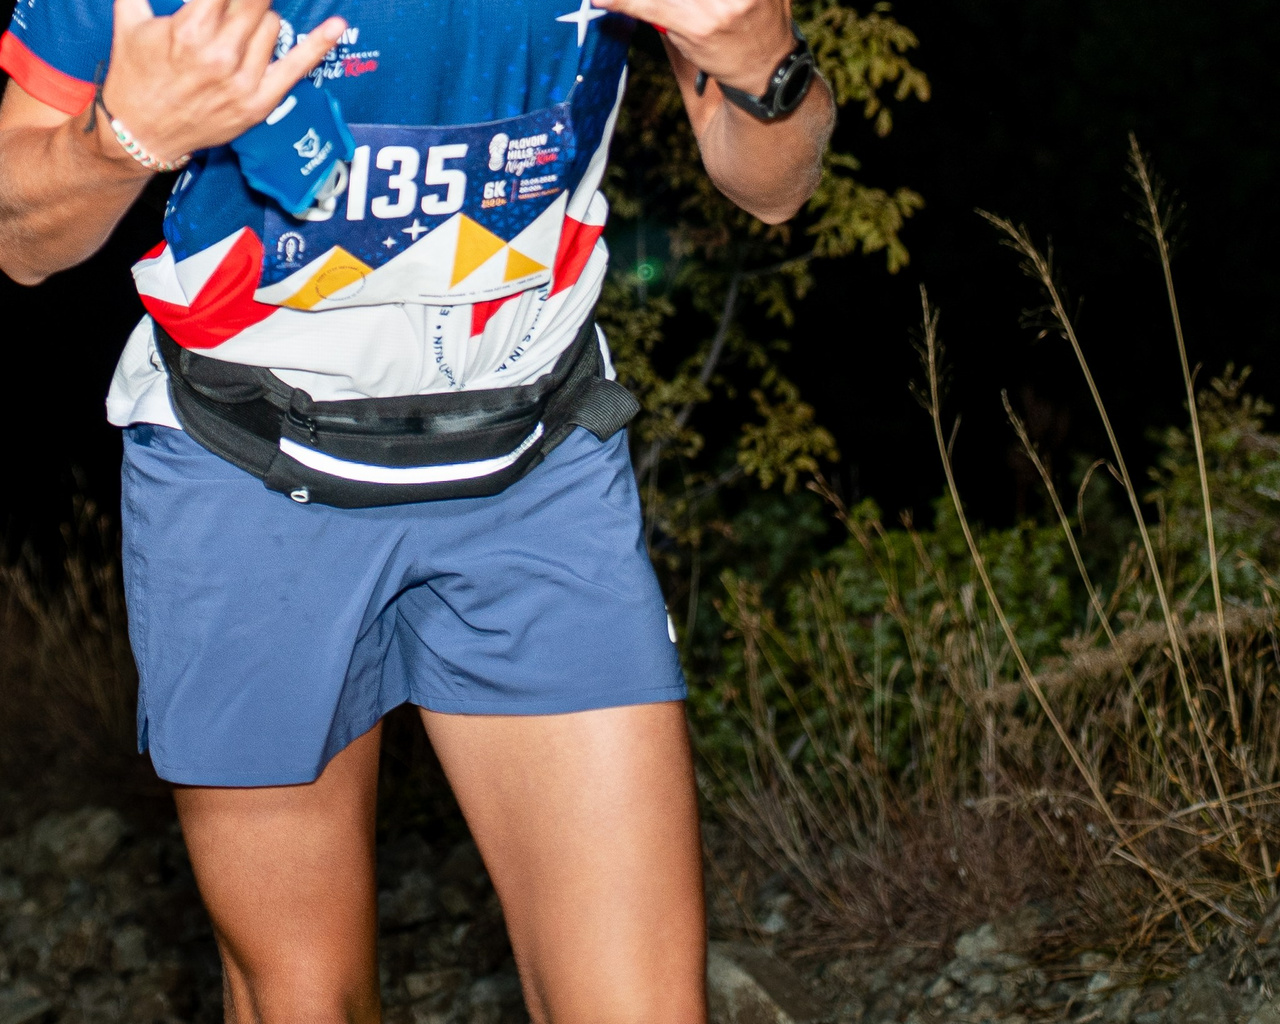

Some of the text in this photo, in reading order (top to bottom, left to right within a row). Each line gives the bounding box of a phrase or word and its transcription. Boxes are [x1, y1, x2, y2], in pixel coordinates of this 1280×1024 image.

[508, 133, 549, 151] PLOVDIV
[506, 146, 535, 162] HILLS
[293, 142, 469, 222] 135
[483, 179, 508, 199] 6K
